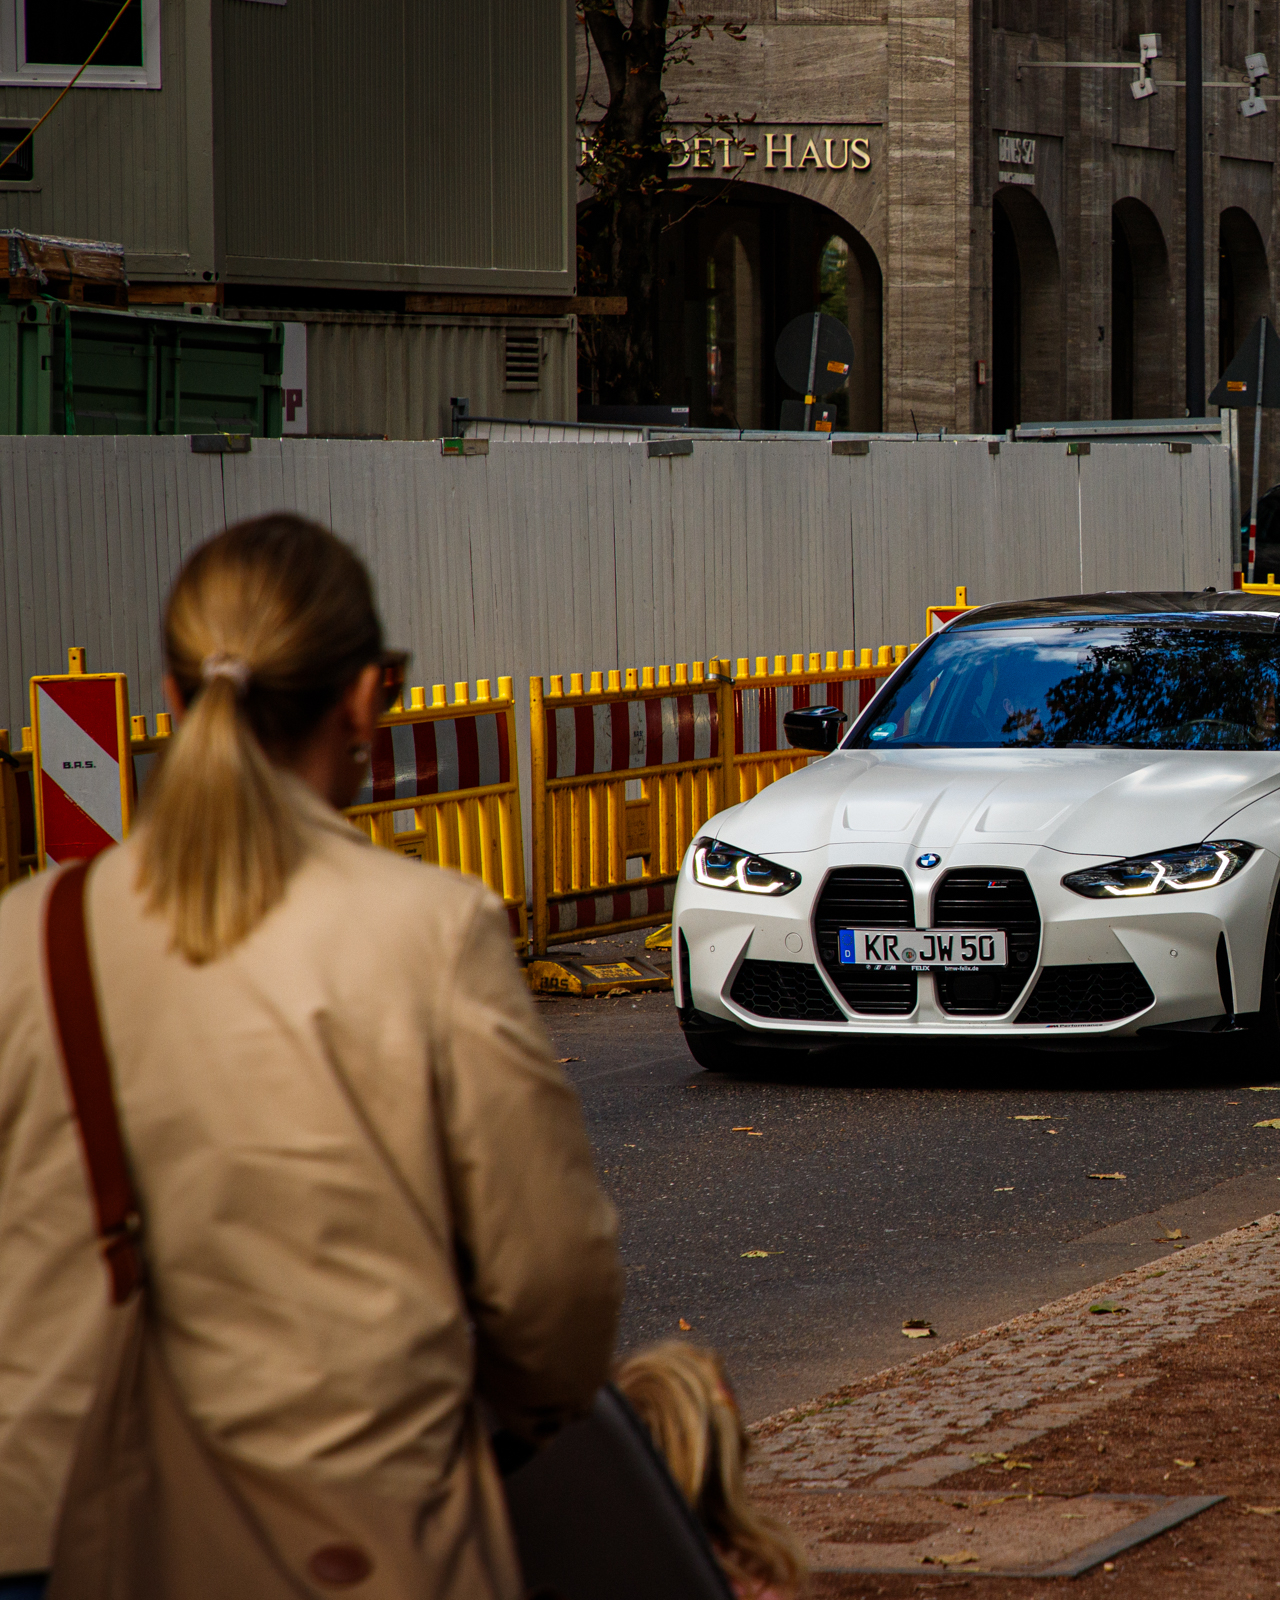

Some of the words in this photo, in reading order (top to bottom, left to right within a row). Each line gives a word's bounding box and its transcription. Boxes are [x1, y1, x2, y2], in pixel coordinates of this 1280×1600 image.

[63, 761, 97, 769] B.A.S.
[865, 934, 900, 961] KR
[919, 934, 954, 961] JW
[961, 934, 995, 961] 50
[844, 950, 851, 958] D
